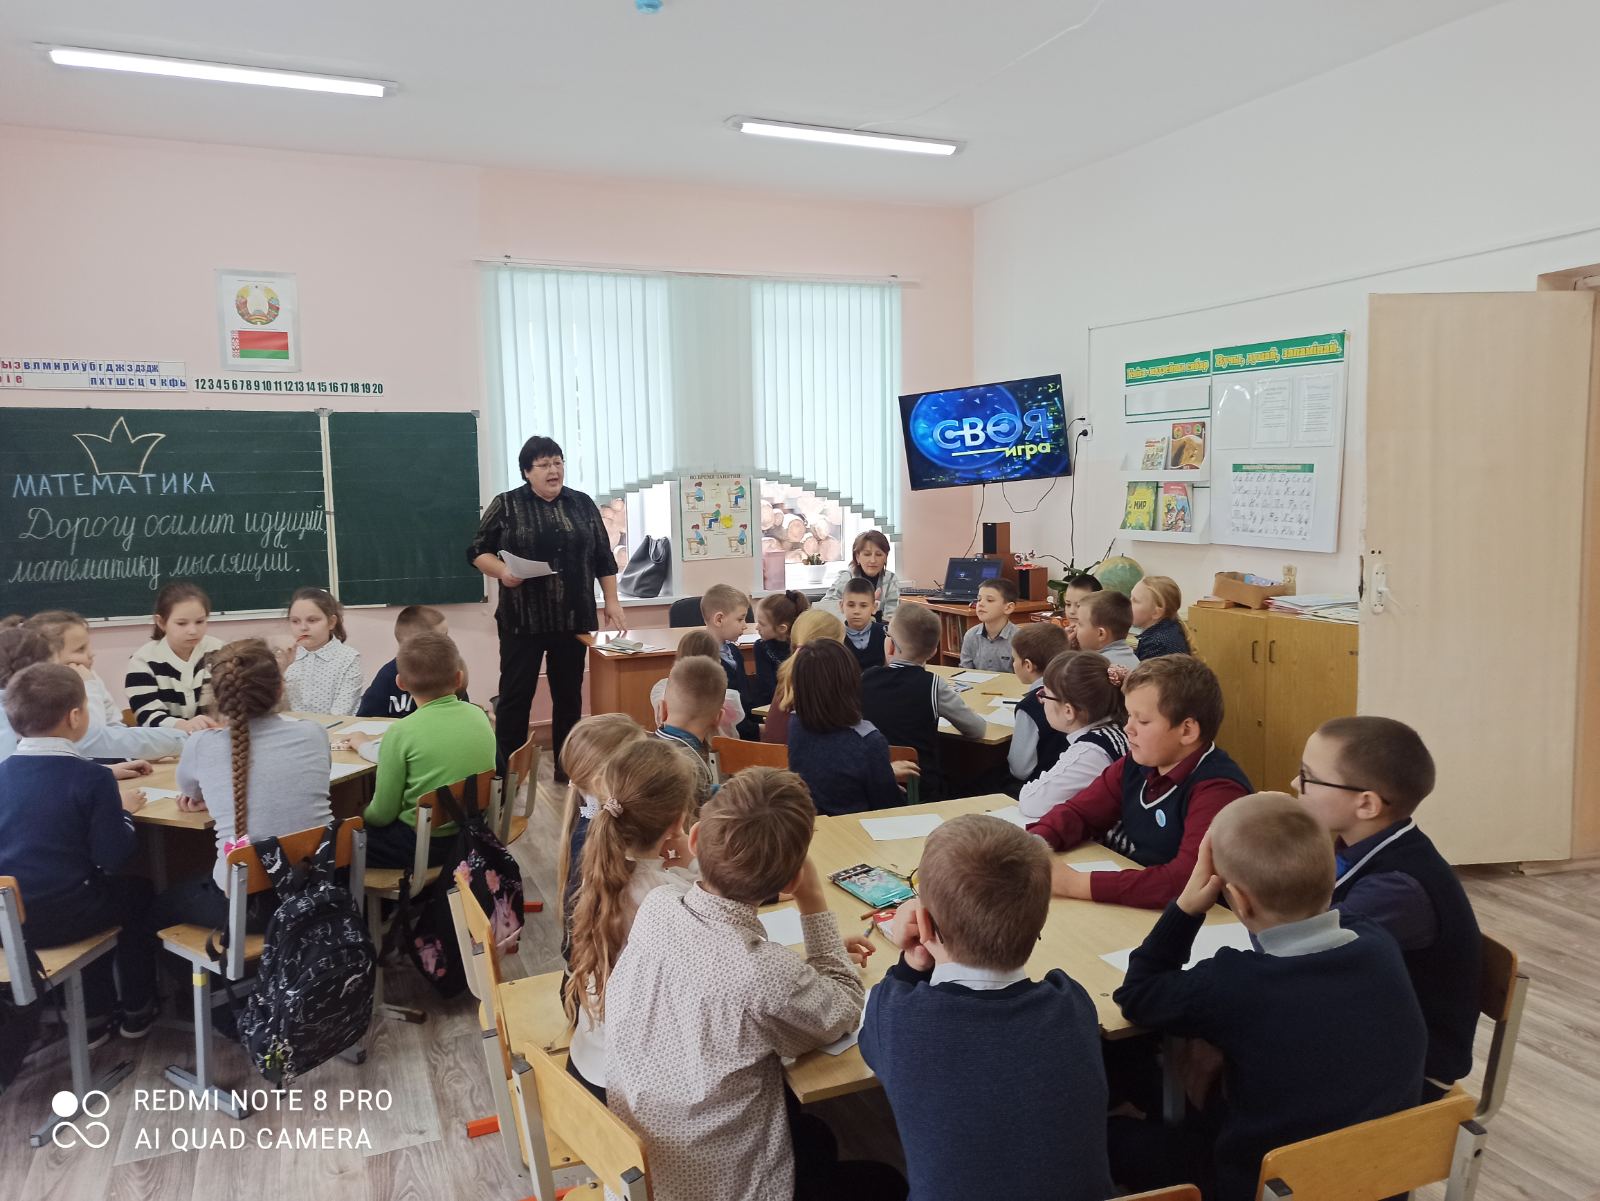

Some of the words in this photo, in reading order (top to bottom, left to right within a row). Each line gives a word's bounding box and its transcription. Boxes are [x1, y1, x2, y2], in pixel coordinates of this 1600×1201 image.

[195, 378, 200, 390] 1
[200, 378, 206, 390] 2
[208, 378, 214, 390] 3
[215, 379, 222, 390] 4
[223, 379, 230, 390] 5
[231, 379, 238, 390] 6
[239, 379, 244, 391] 7
[245, 379, 252, 391] 8
[253, 380, 260, 391] 9
[262, 380, 272, 391] 10
[274, 380, 282, 392] 11
[284, 380, 294, 392] 12
[295, 381, 304, 392] 13
[306, 381, 316, 393] 14
[317, 381, 327, 393] 15
[329, 382, 338, 393] 16
[340, 382, 349, 393] 17
[350, 382, 360, 394] 18
[361, 383, 371, 394] 19
[372, 383, 384, 394] 20
[933, 409, 1049, 449] СВОЯ
[1004, 443, 1051, 460] игра
[13, 472, 215, 498] МАТЕМАТИКА
[18, 507, 136, 555] Дорогу
[144, 512, 235, 538] осилит
[245, 505, 328, 549] идущий,
[8, 555, 161, 590] математику
